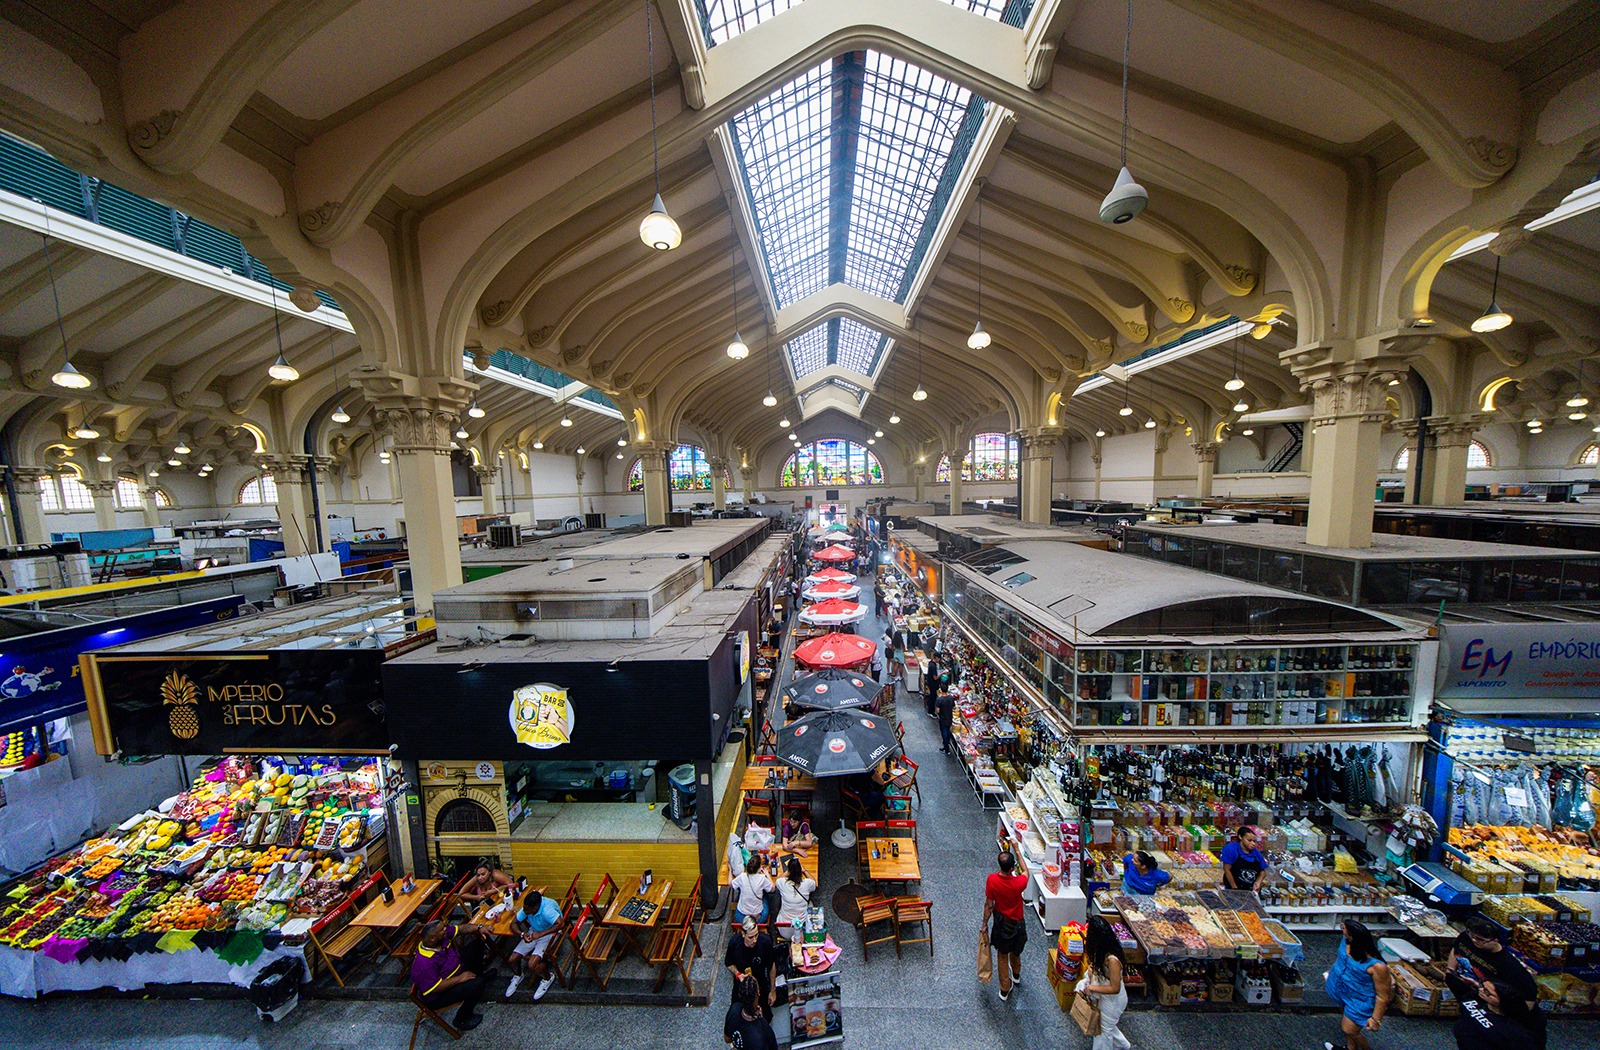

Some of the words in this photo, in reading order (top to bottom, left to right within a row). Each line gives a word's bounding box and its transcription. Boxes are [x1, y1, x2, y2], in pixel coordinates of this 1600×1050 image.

[1460, 638, 1513, 679] EM
[207, 680, 284, 702] IMPÉRIO
[543, 694, 557, 704] BAR
[840, 697, 859, 705] AMSTEL
[234, 704, 337, 726] FRUTAS
[788, 753, 810, 767] AMSTEL
[870, 744, 888, 760] AMSTEL
[1463, 1000, 1494, 1029] BEATLES
